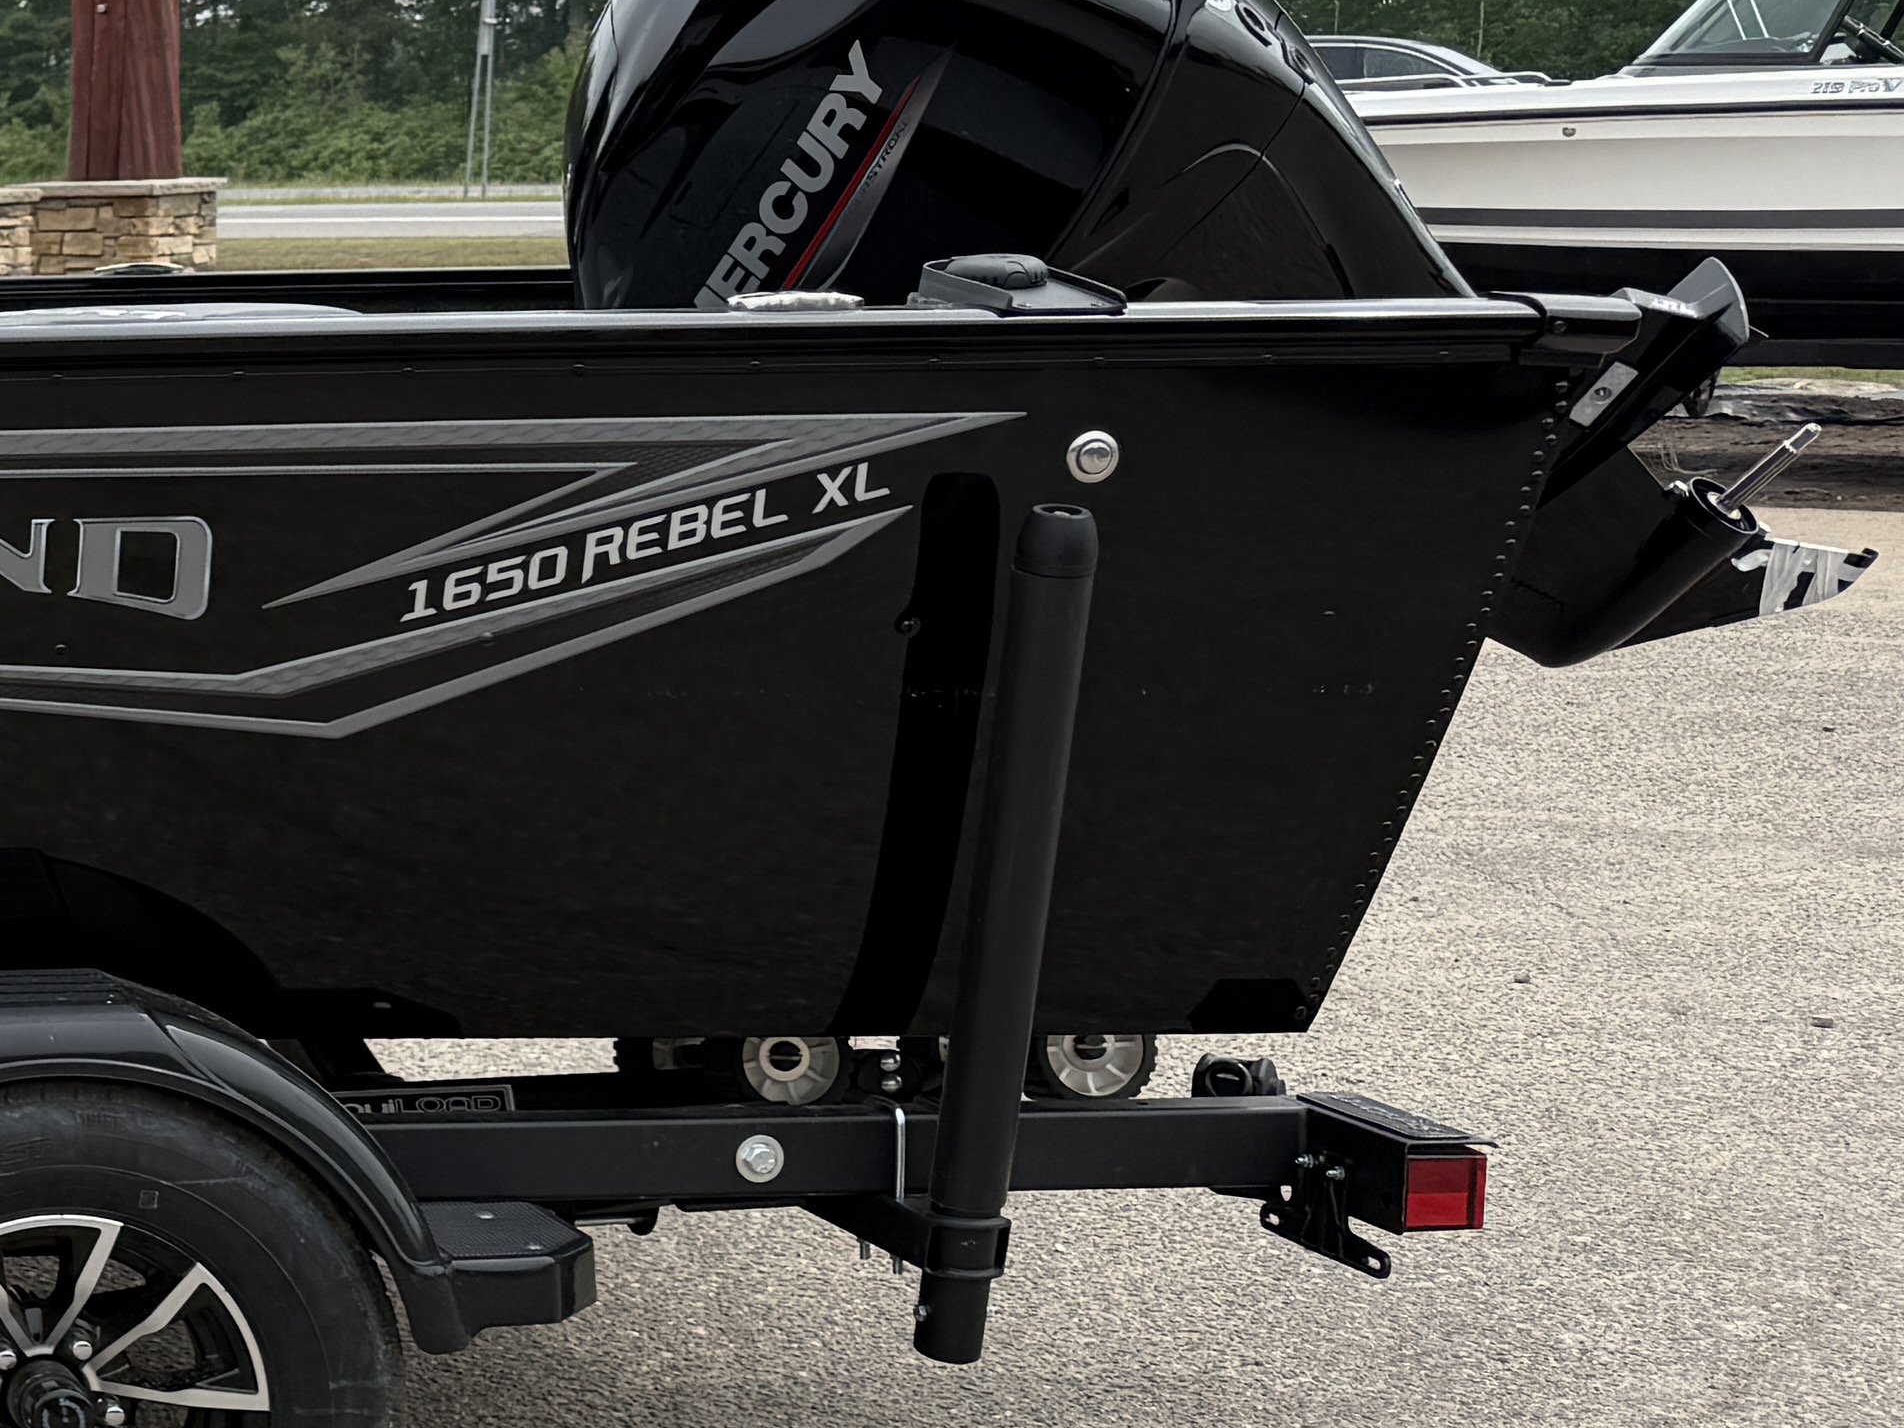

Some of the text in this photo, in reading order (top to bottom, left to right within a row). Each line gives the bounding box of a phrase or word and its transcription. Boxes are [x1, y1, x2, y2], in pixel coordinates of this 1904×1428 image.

[693, 39, 884, 309] ERCURY
[399, 461, 891, 623] 1650 REBEL XL
